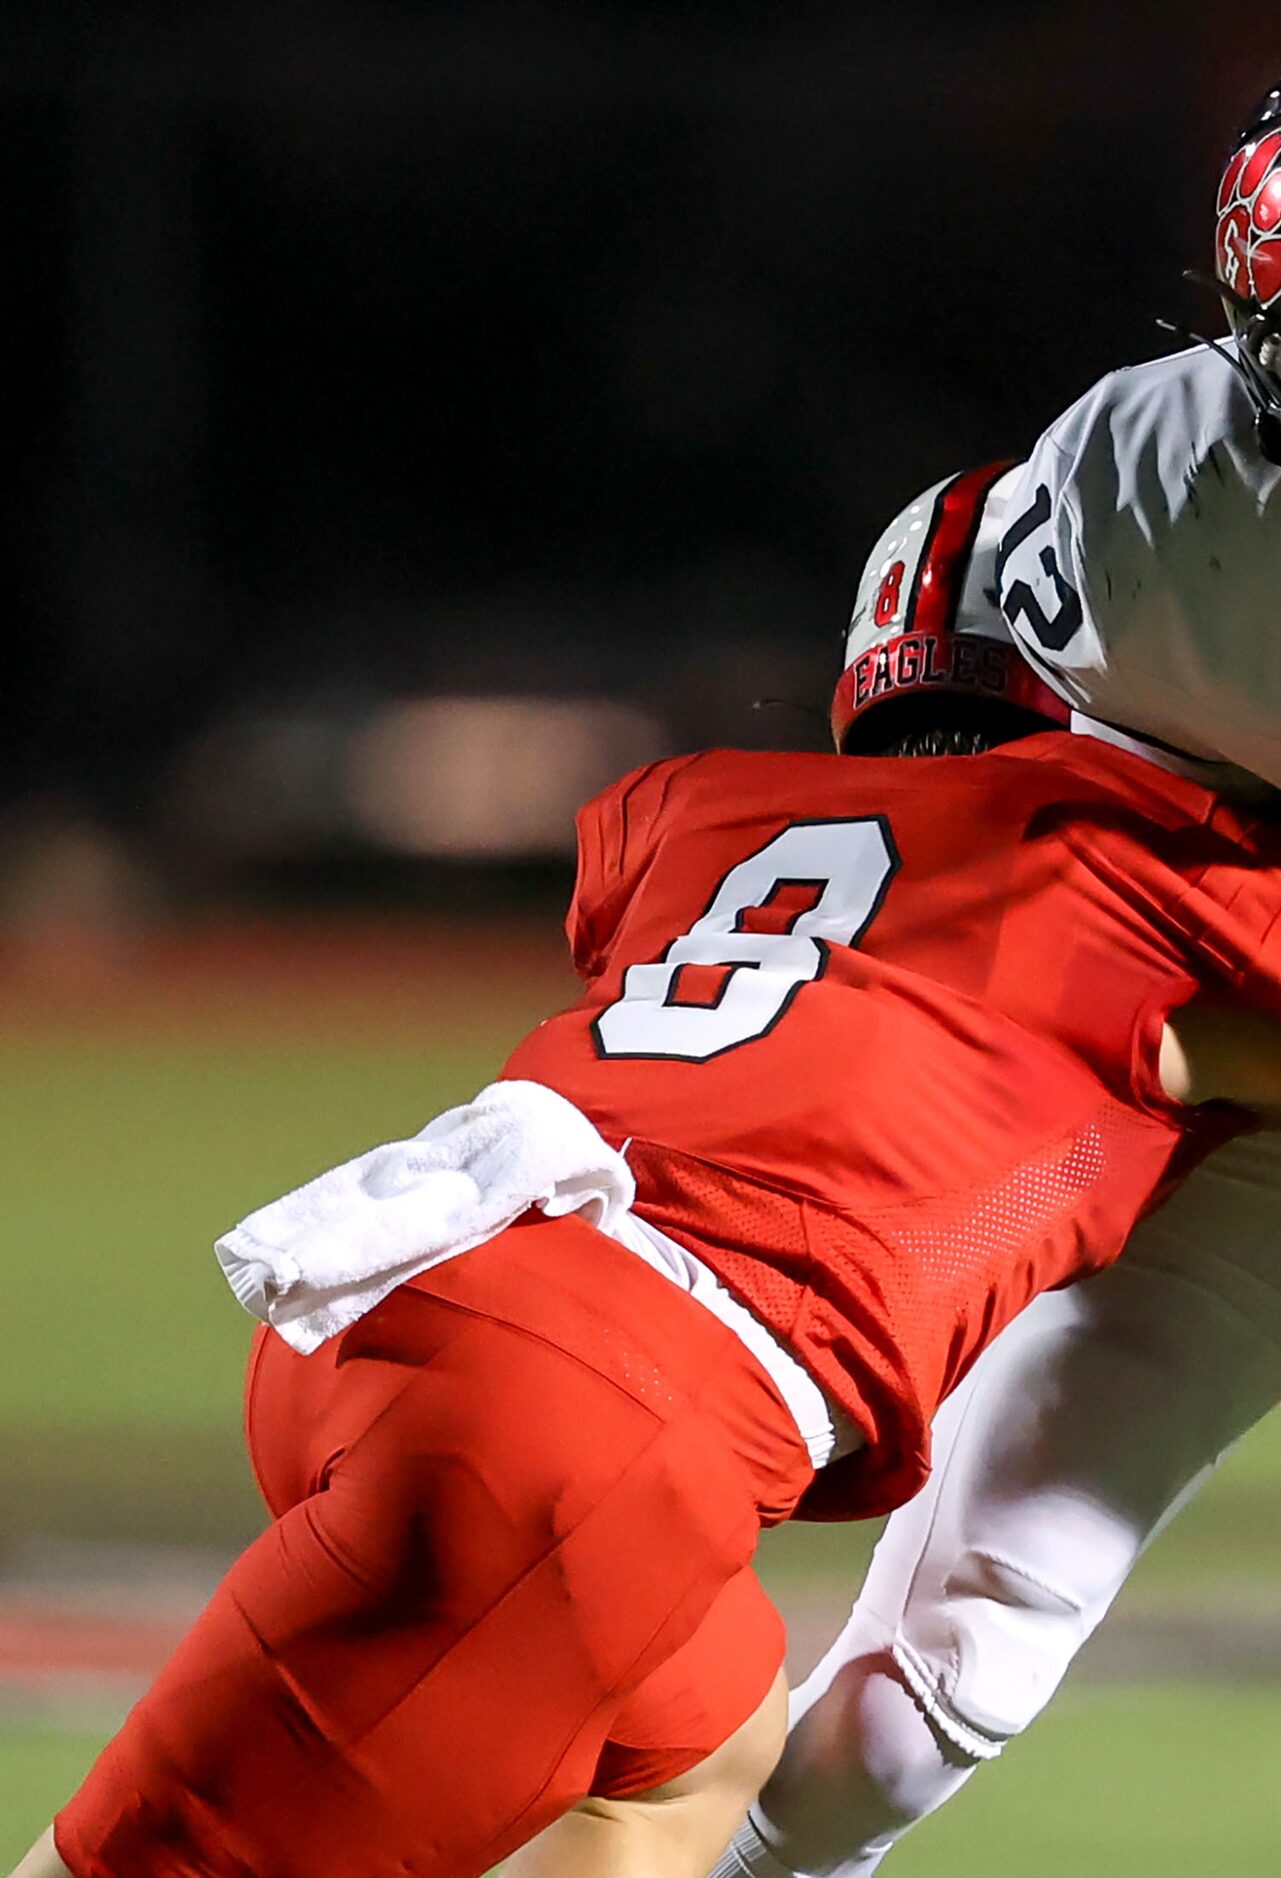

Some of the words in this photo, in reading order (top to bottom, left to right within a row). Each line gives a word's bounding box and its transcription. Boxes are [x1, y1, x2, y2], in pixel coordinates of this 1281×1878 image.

[873, 560, 906, 628] 8
[853, 636, 1010, 711] EAGLES
[590, 814, 903, 1065] 8
